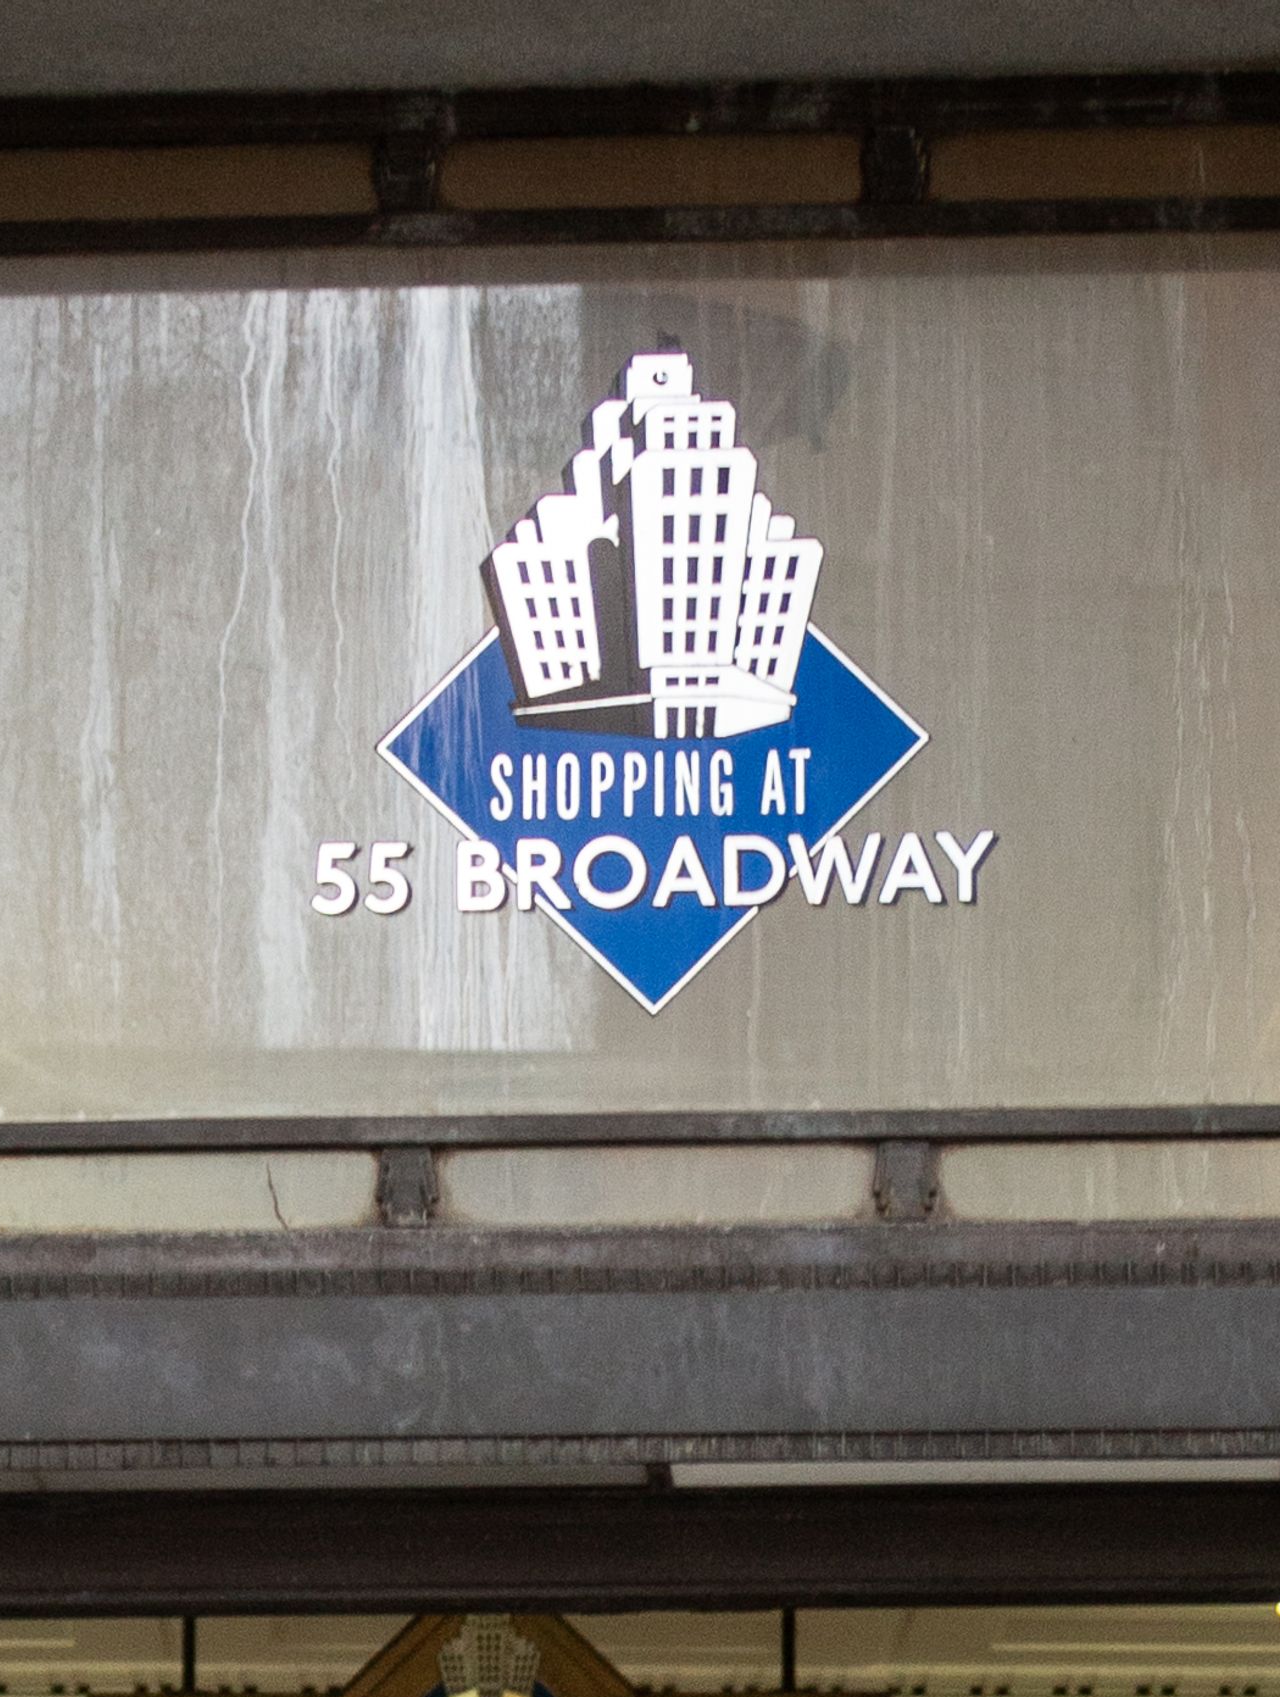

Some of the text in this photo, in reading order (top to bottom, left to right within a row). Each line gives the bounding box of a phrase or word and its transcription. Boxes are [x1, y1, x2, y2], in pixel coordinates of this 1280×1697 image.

[489, 747, 812, 821] SHOPPING AT
[311, 830, 995, 915] 55 BROADWAY
